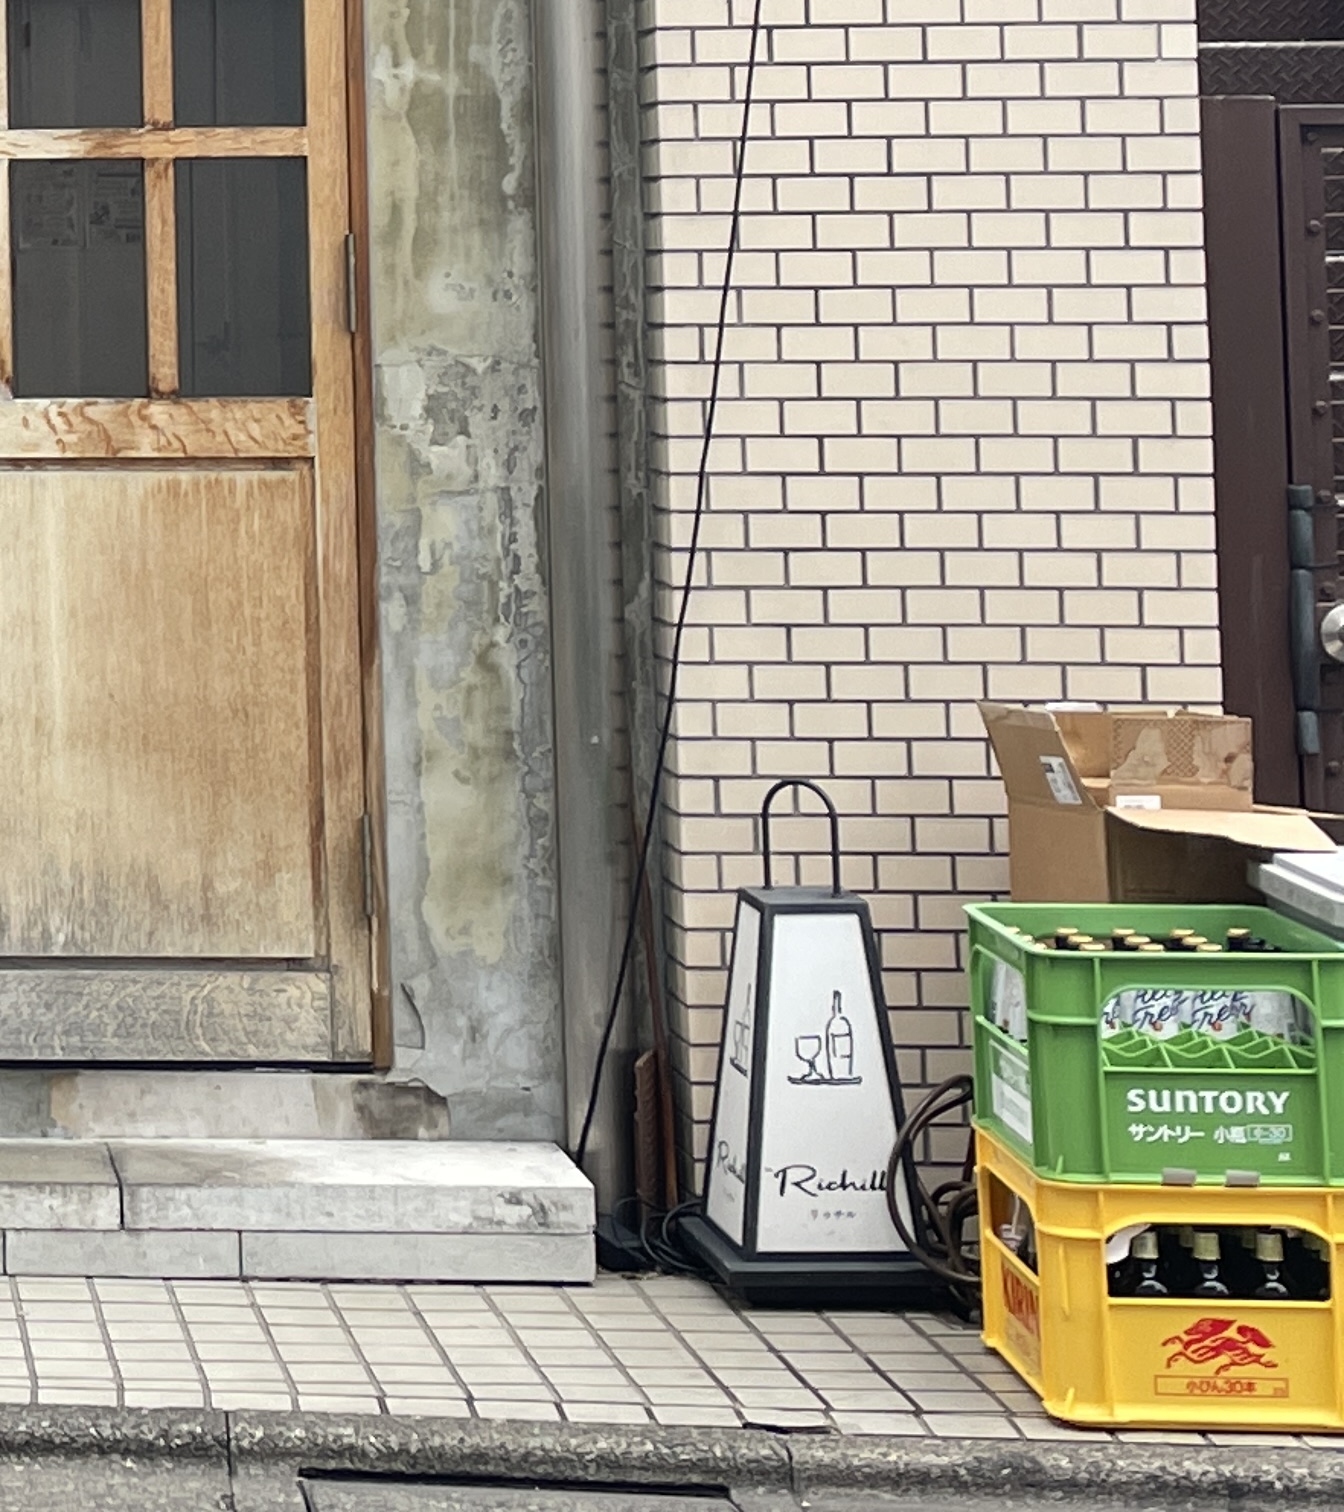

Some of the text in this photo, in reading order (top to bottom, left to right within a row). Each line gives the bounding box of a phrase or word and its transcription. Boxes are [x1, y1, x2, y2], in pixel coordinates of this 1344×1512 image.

[1126, 1088, 1290, 1115] SUNTORY
[1128, 1123, 1205, 1143] サントリー
